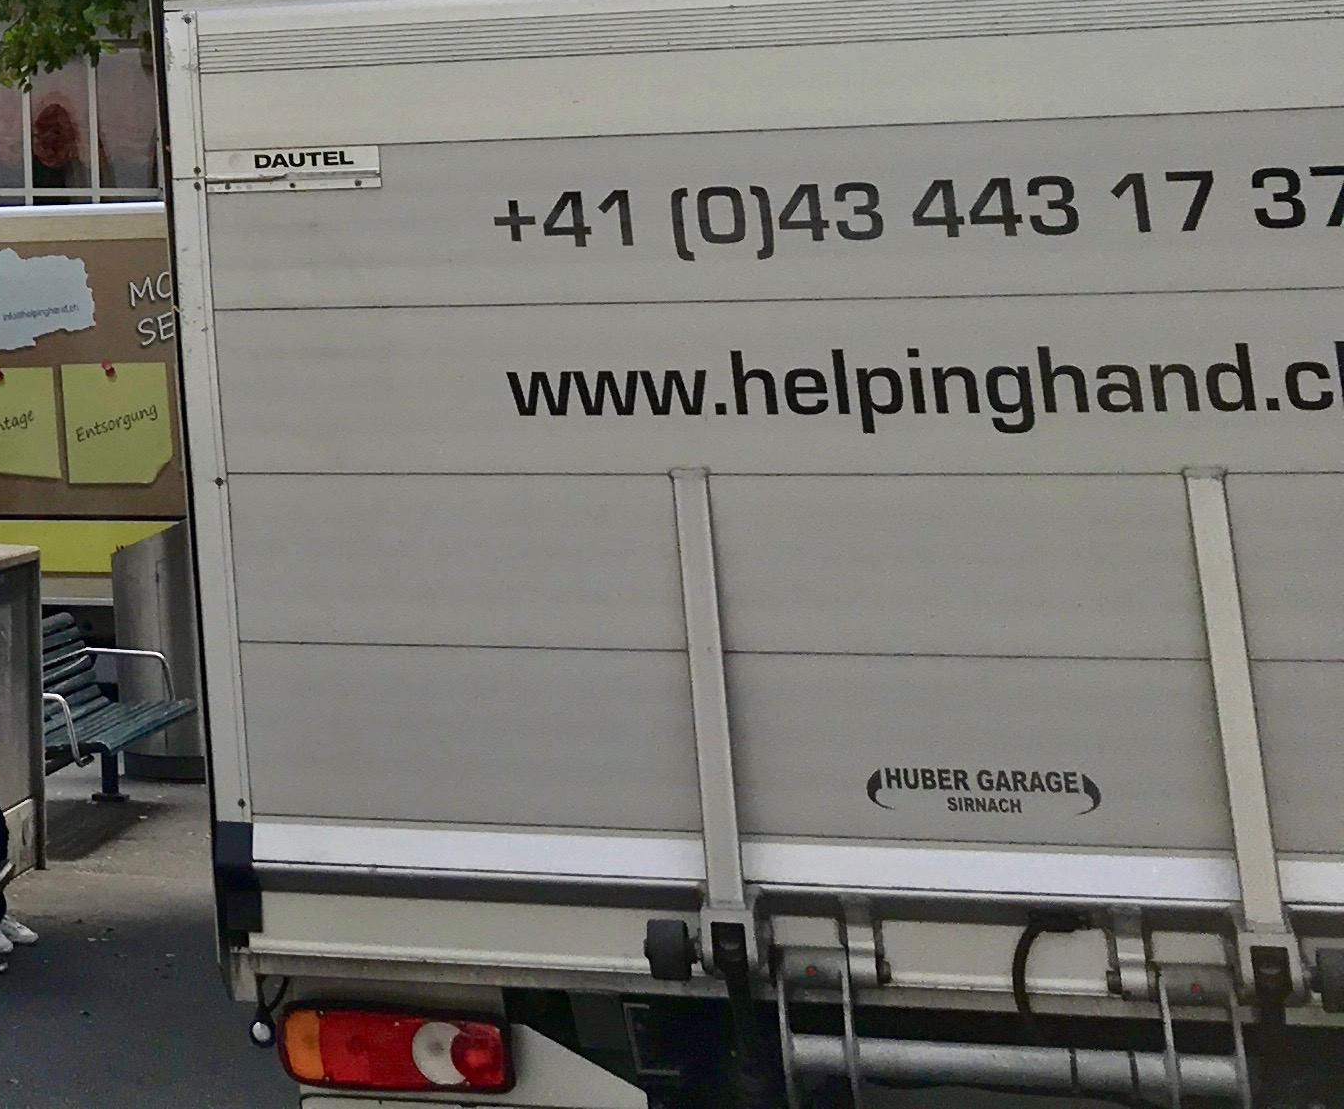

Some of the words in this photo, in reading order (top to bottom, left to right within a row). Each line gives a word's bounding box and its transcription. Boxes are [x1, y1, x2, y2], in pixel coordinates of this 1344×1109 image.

[254, 151, 354, 169] DAUTEL
[493, 189, 634, 247] +41
[670, 182, 884, 261] (0)43
[912, 175, 1080, 238] 443
[1111, 170, 1214, 233] 17
[1251, 165, 1344, 229] 37
[505, 340, 1344, 434] www.helpinghand.c
[75, 404, 159, 443] Entsorgung
[884, 767, 970, 792] HUBER
[977, 769, 1081, 794] GARAGE
[947, 796, 1022, 814] SIRNACH
